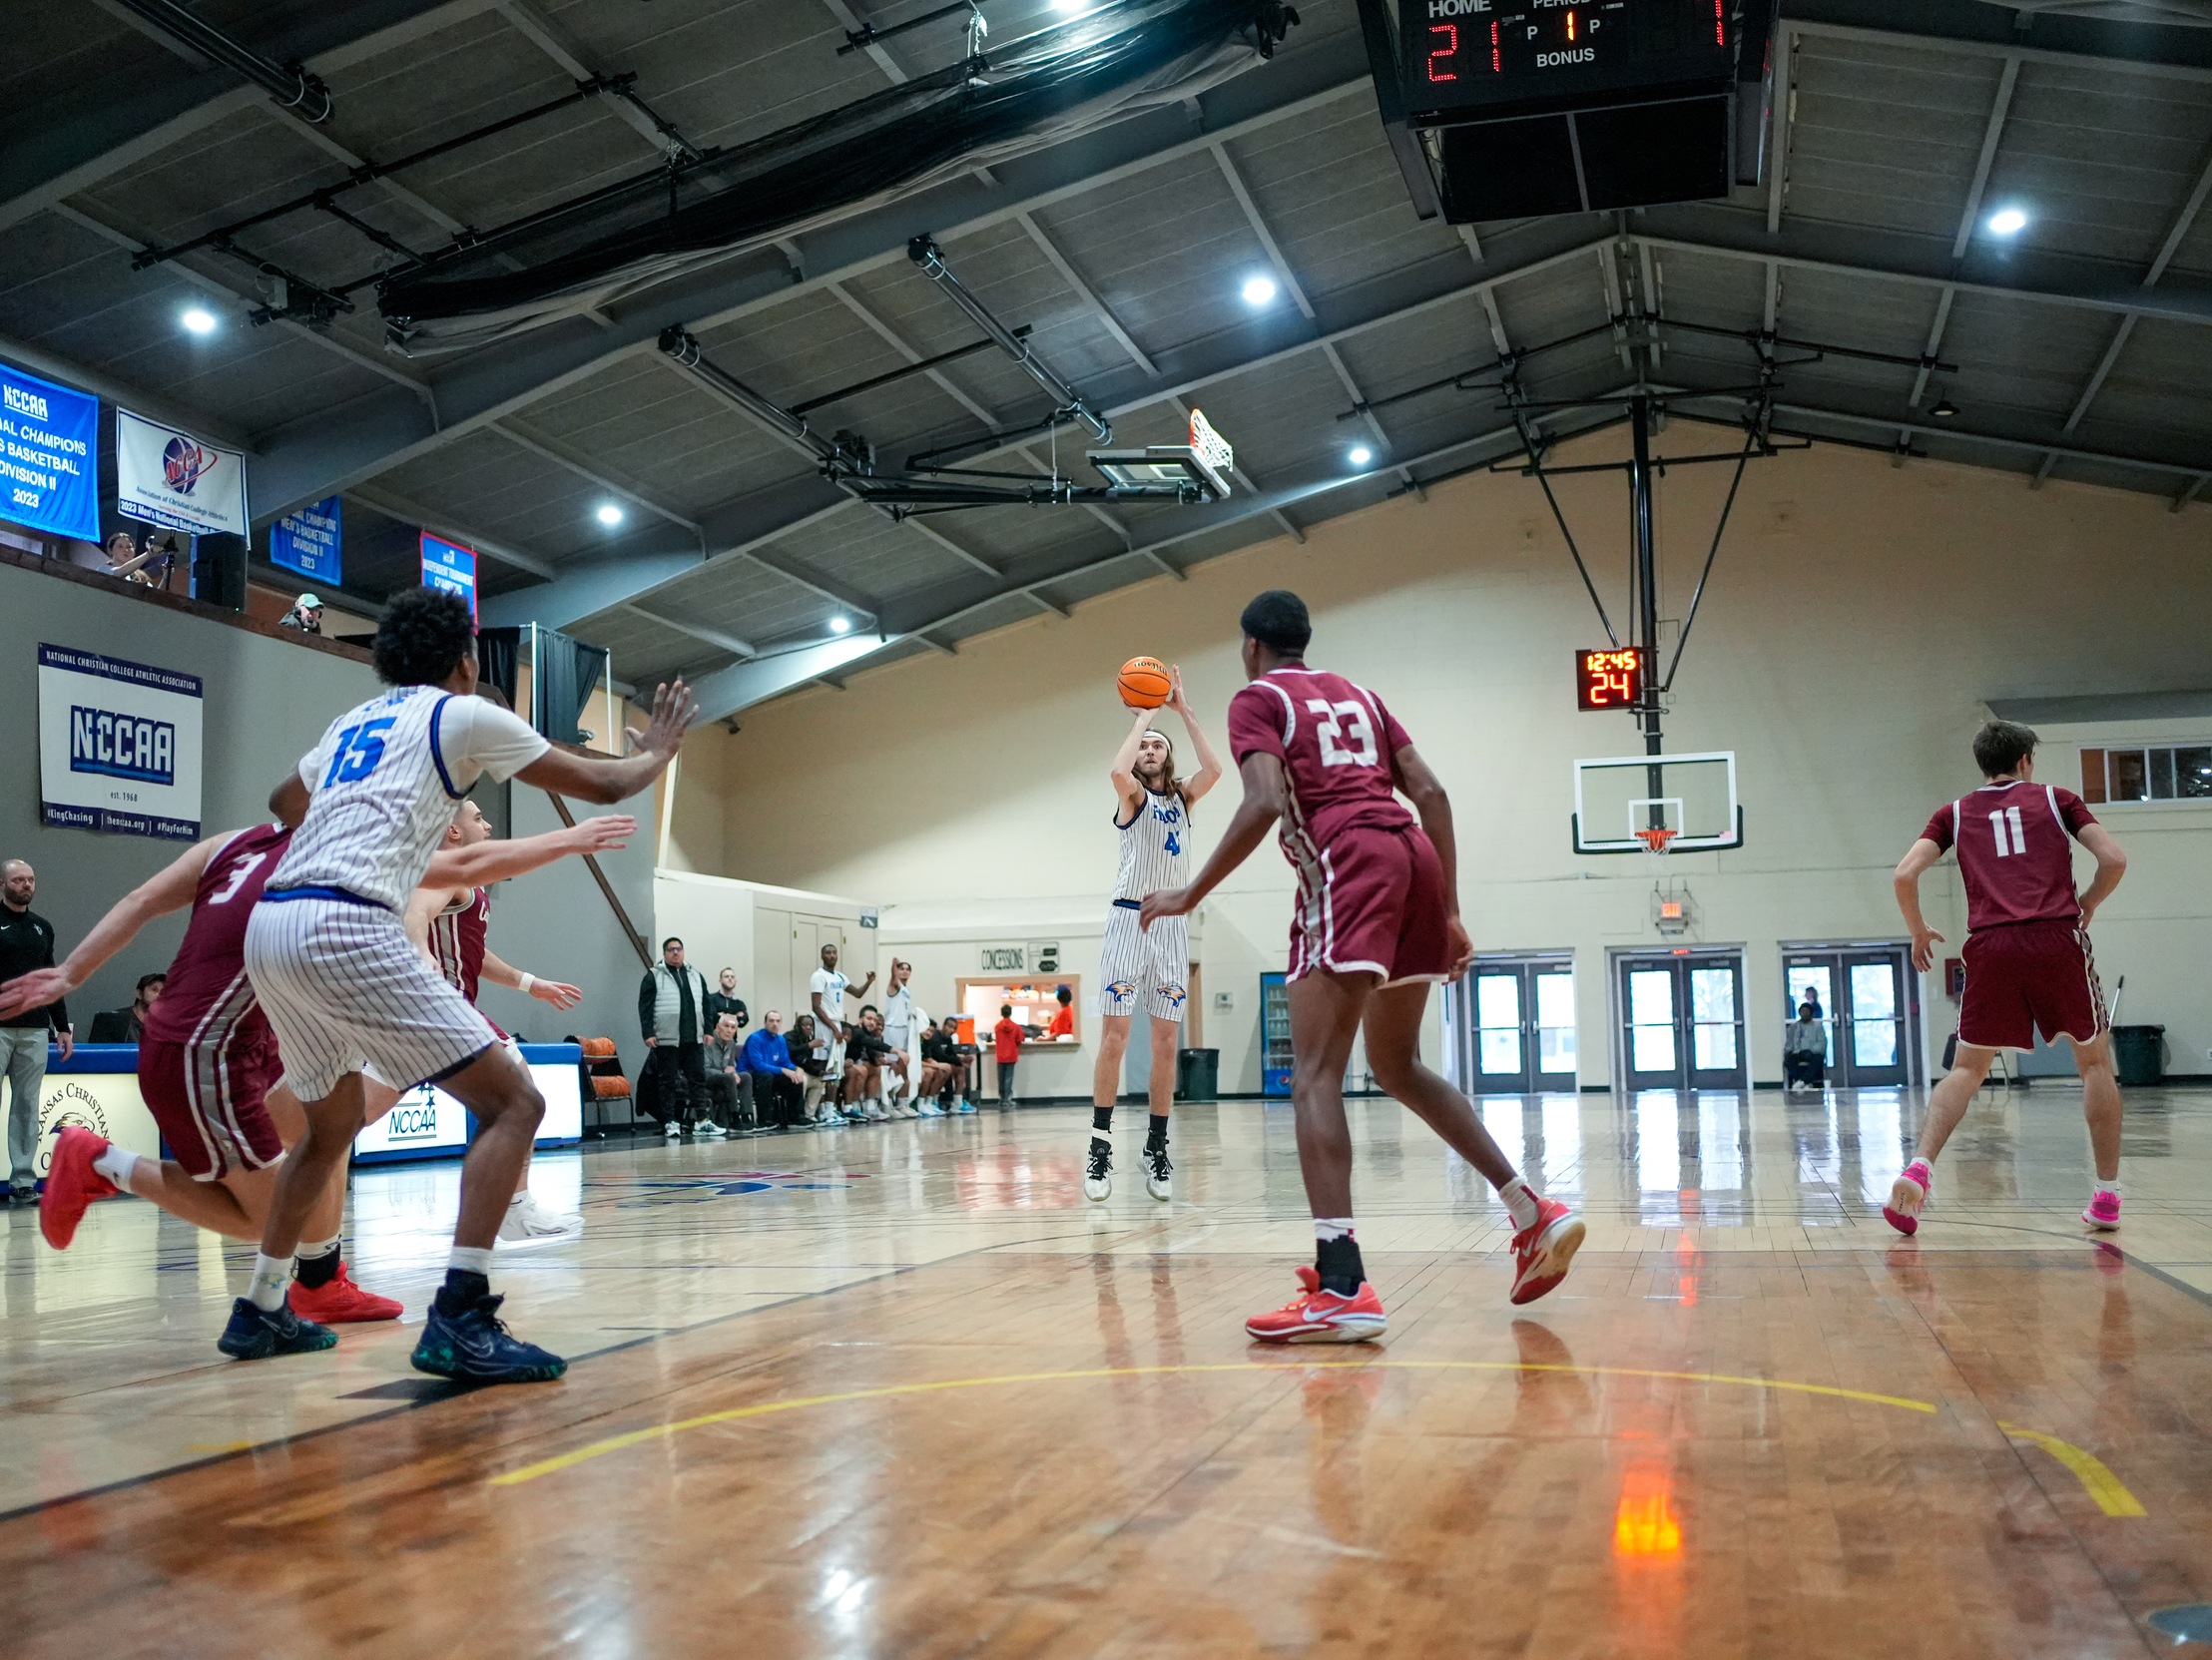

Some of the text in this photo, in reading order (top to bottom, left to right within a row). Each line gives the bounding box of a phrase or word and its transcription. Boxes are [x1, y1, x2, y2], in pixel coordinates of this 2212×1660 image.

[1428, 0, 1492, 18] HOME
[1536, 48, 1595, 68] BONUS
[3, 384, 48, 417] NCCAA
[20, 425, 87, 456] CHAMPIONS
[7, 441, 81, 476] BASKETBALL
[0, 460, 56, 491] DIVISION II
[13, 488, 39, 508] 2023
[120, 500, 137, 513] 2023
[138, 504, 156, 519] Men's
[156, 511, 179, 527] National
[292, 536, 318, 556] DIVISION
[300, 524, 334, 546] BASKETBALL
[300, 555, 315, 570] 2023
[46, 650, 197, 691] NATIONAL CHRISTIAN COLLEGE ATHLETIC ASSOCIATION
[1587, 651, 1636, 672] 12:45
[1590, 673, 1629, 703] 24
[72, 709, 174, 774] NCCAA
[1305, 699, 1379, 767] 23
[322, 716, 397, 789] 15
[110, 791, 138, 803] est. 1968
[47, 810, 94, 825] #KingChasing
[157, 822, 194, 835] #PlayForHim
[1987, 806, 2026, 857] 11
[208, 852, 268, 904] 3
[980, 948, 1024, 970] CONCESSIONS
[66, 1082, 110, 1140] CHRISTIAN
[388, 1108, 436, 1135] NCCAA
